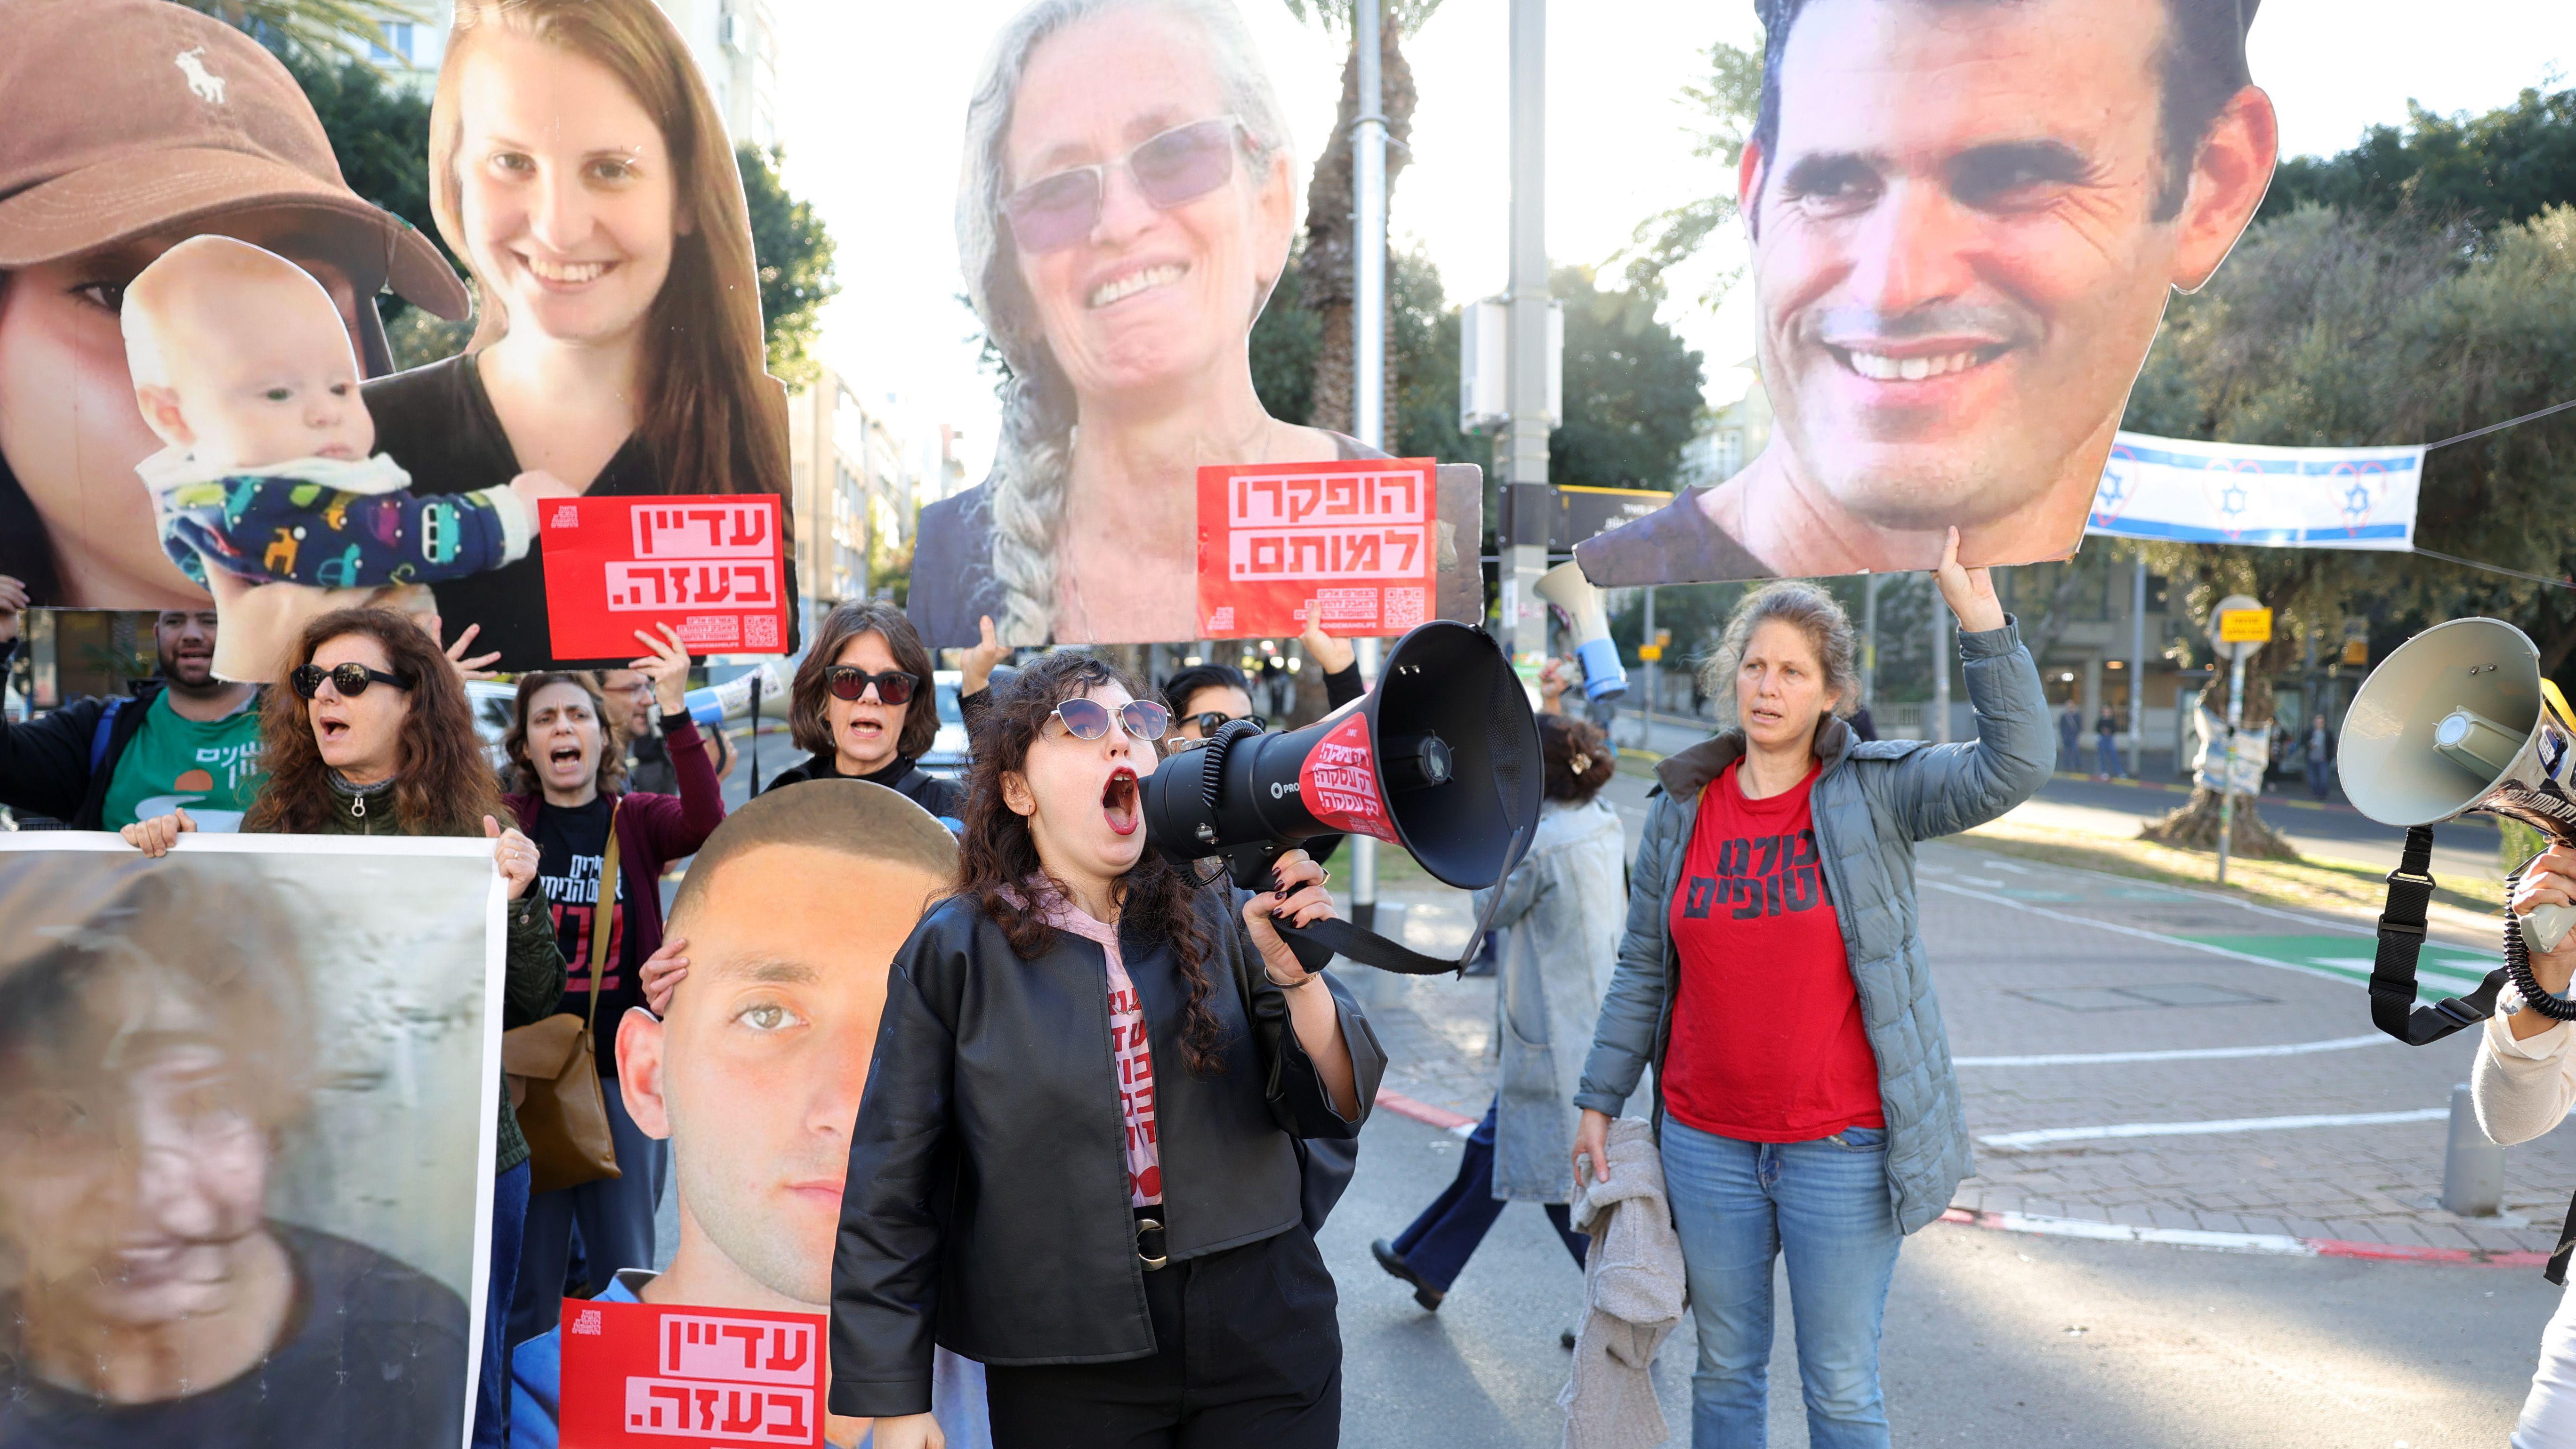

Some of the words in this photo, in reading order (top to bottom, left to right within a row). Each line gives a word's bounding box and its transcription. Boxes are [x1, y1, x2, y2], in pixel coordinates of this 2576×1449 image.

[1237, 476, 1416, 523] הופקרו
[639, 510, 765, 554] עדיין
[1235, 530, 1419, 574] למותם.
[613, 567, 772, 604] בעזה.
[668, 1320, 808, 1372] עדיין
[630, 1385, 808, 1438] בעזה.
